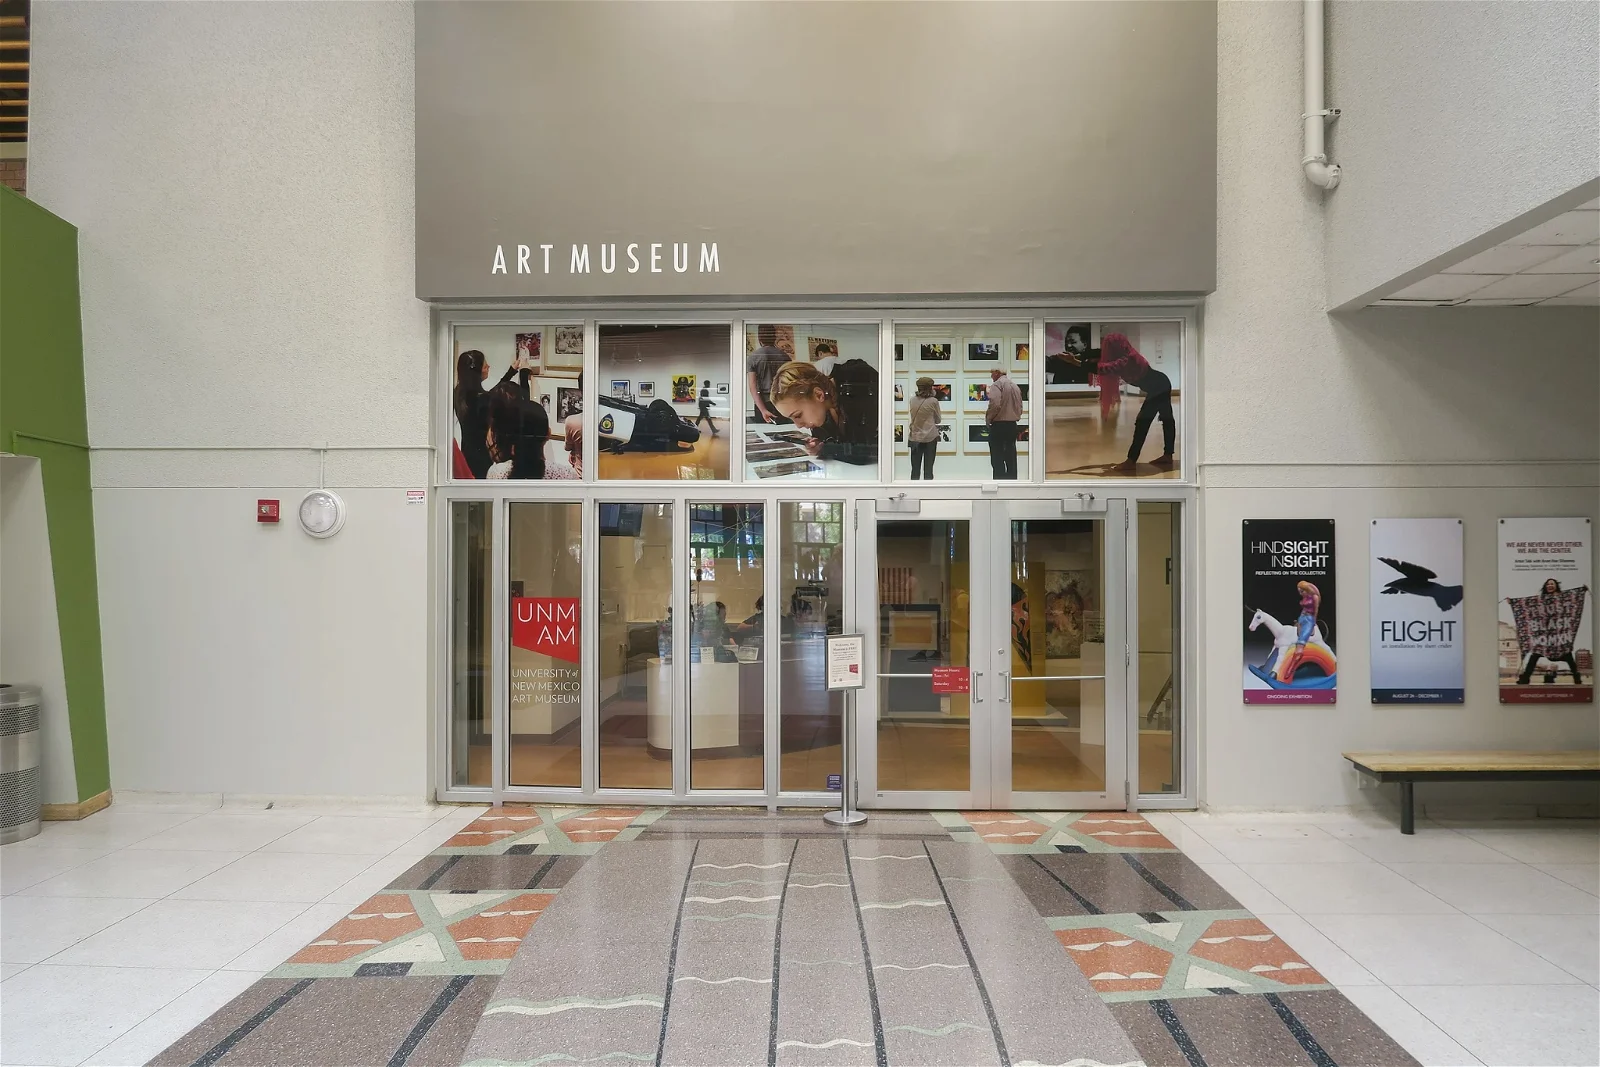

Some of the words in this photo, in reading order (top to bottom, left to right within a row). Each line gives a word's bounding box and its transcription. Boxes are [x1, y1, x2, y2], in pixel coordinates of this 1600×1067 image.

[491, 244, 554, 274] ART
[570, 242, 720, 274] MUSEUM
[1251, 540, 1330, 554] HINDSIGHT
[1271, 555, 1330, 568] INSIGHT
[518, 602, 576, 622] UNM
[537, 625, 576, 645] AM
[1381, 620, 1456, 642] FLIGHT
[512, 668, 572, 678] UNIVERSITY
[572, 669, 579, 678] of
[512, 682, 536, 691] NEW
[538, 682, 580, 691] MEXICO
[512, 694, 532, 703] ART
[535, 694, 580, 704] MUSEUM
